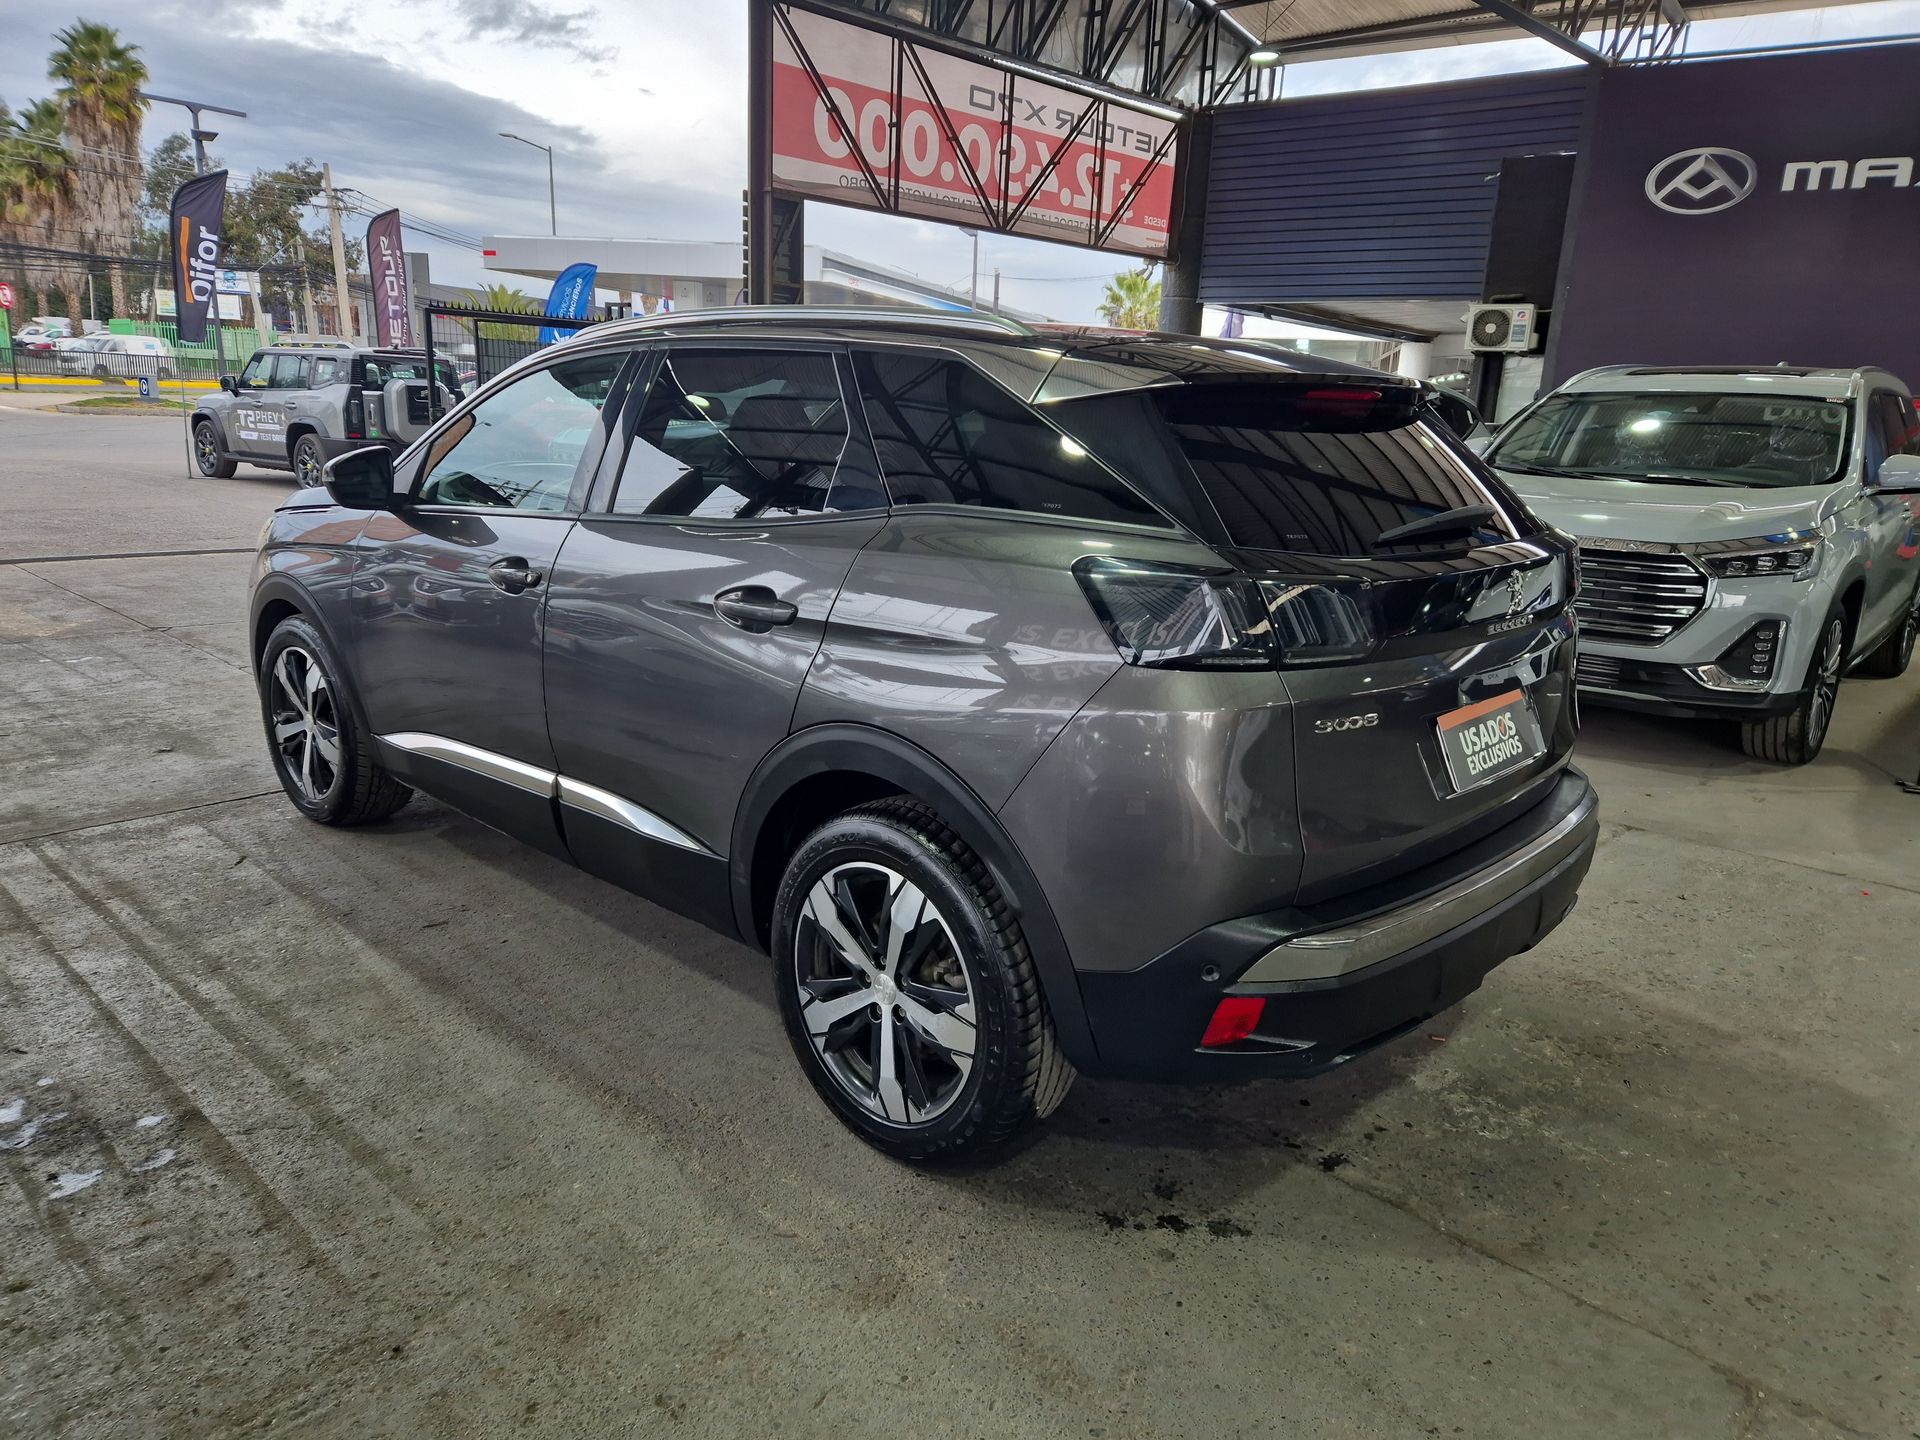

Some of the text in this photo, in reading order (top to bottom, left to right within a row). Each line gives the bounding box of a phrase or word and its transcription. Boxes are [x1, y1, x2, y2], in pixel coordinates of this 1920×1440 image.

[1781, 156, 1920, 192] MA
[190, 225, 219, 302] Difor
[395, 249, 407, 286] Future
[237, 409, 257, 429] T2
[255, 410, 279, 424] PHEV
[1314, 712, 1379, 734] 3008
[1459, 712, 1517, 756] USADOS
[1466, 736, 1523, 776] EXCLUSIVOS
